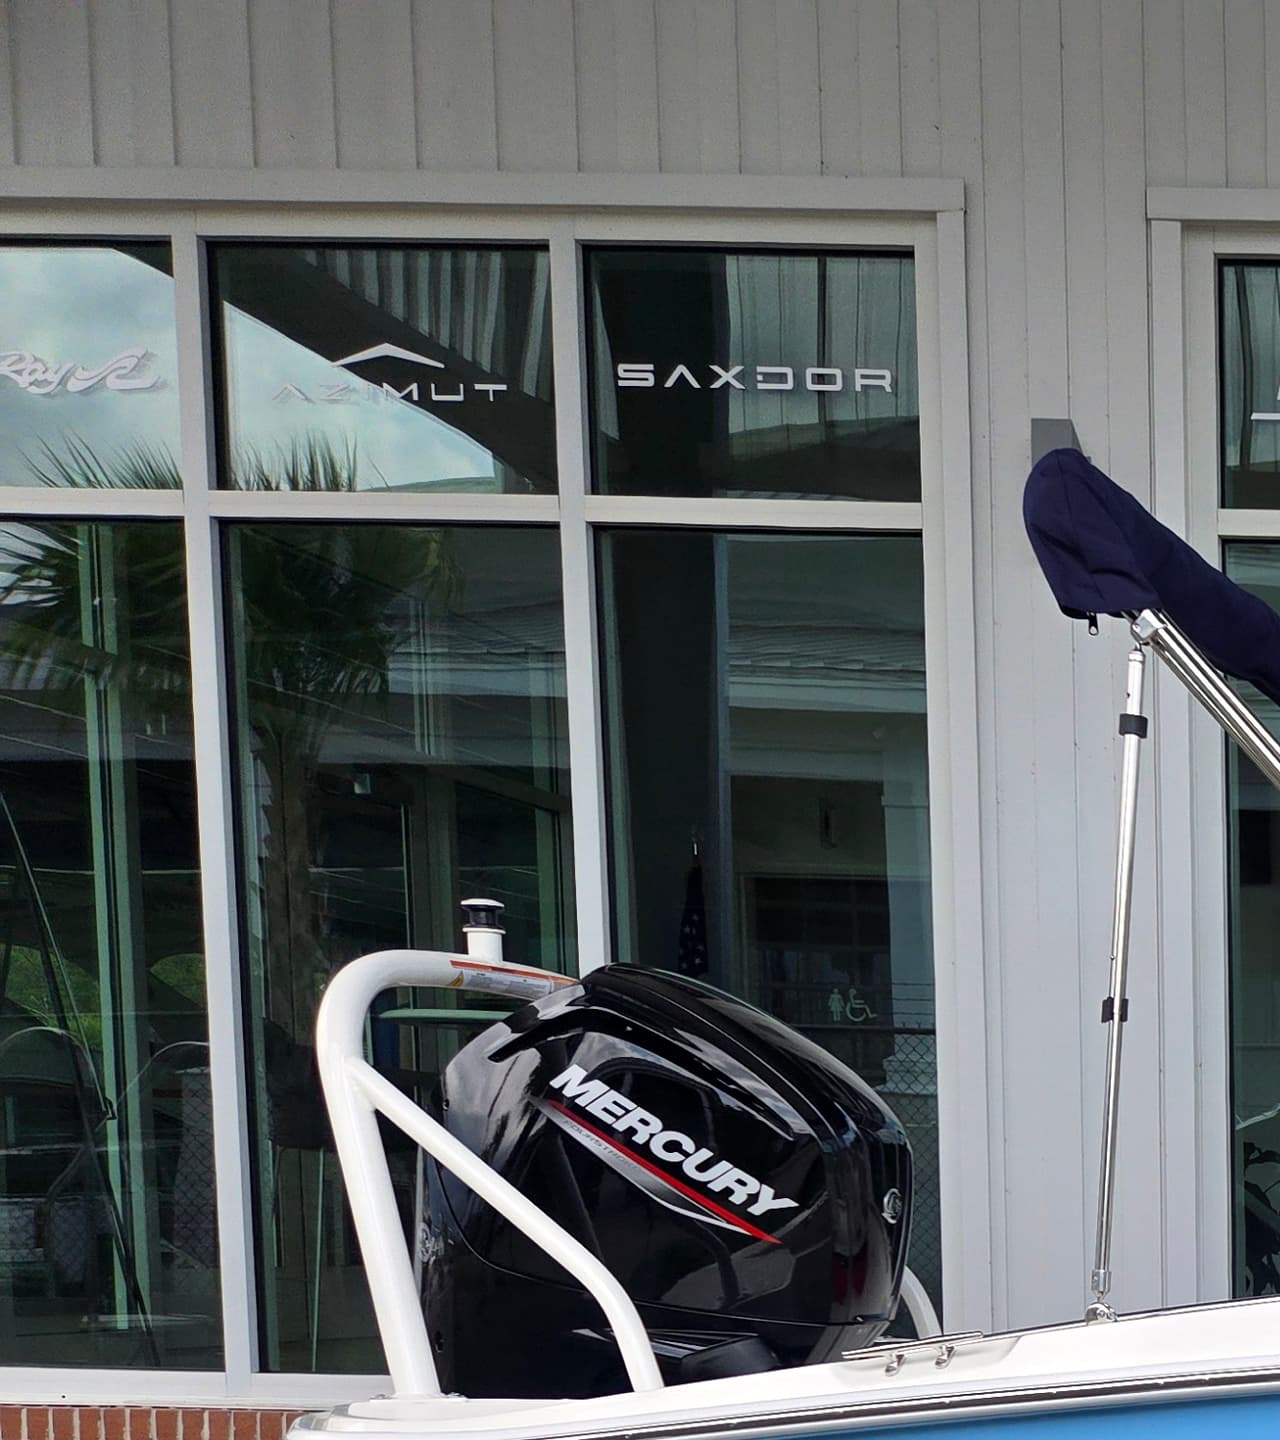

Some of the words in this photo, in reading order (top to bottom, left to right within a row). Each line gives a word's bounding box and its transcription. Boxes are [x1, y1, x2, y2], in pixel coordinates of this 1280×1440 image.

[271, 382, 508, 403] AZIMUT
[617, 363, 893, 393] SAXDOR
[549, 1064, 800, 1216] MERCURY
